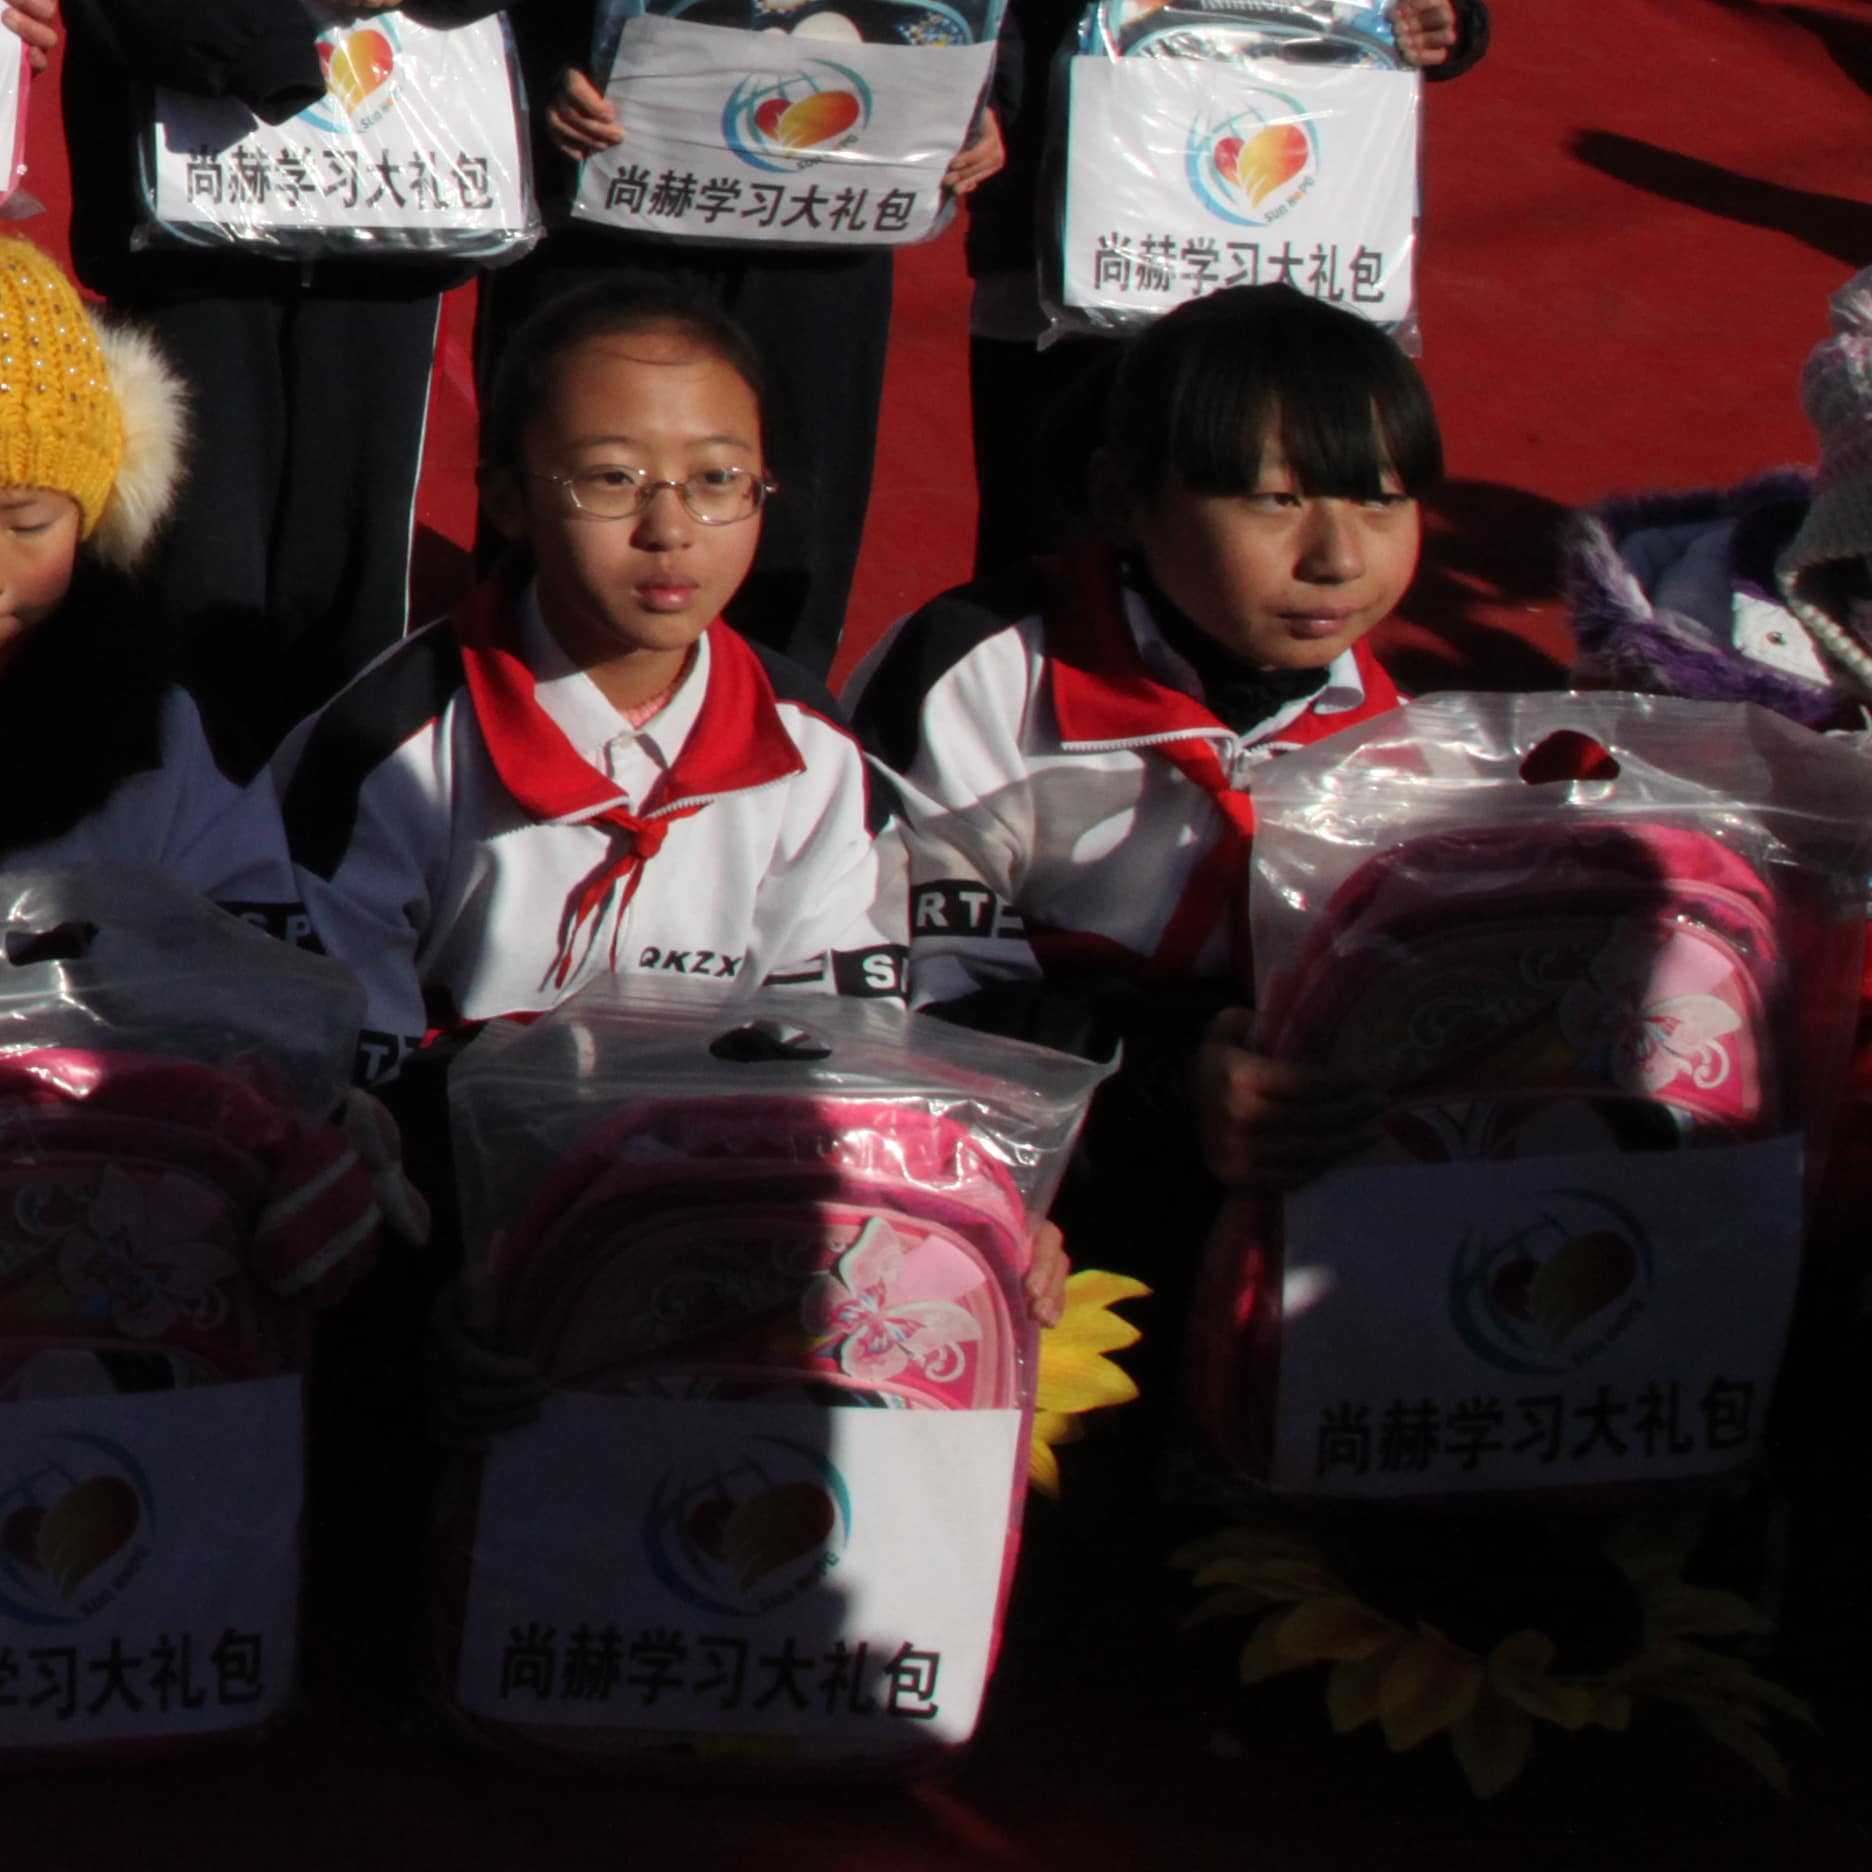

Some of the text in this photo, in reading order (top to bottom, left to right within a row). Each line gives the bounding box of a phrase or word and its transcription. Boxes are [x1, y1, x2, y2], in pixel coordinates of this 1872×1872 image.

[186, 145, 493, 211] 尚赫学习大礼包
[604, 163, 917, 233] 尚赫学习大礼包
[1094, 234, 1385, 304] 尚赫学习大礼包
[1317, 1375, 1755, 1478] 尚赫学习大礼包
[498, 1624, 940, 1720] 尚赫学习大礼包
